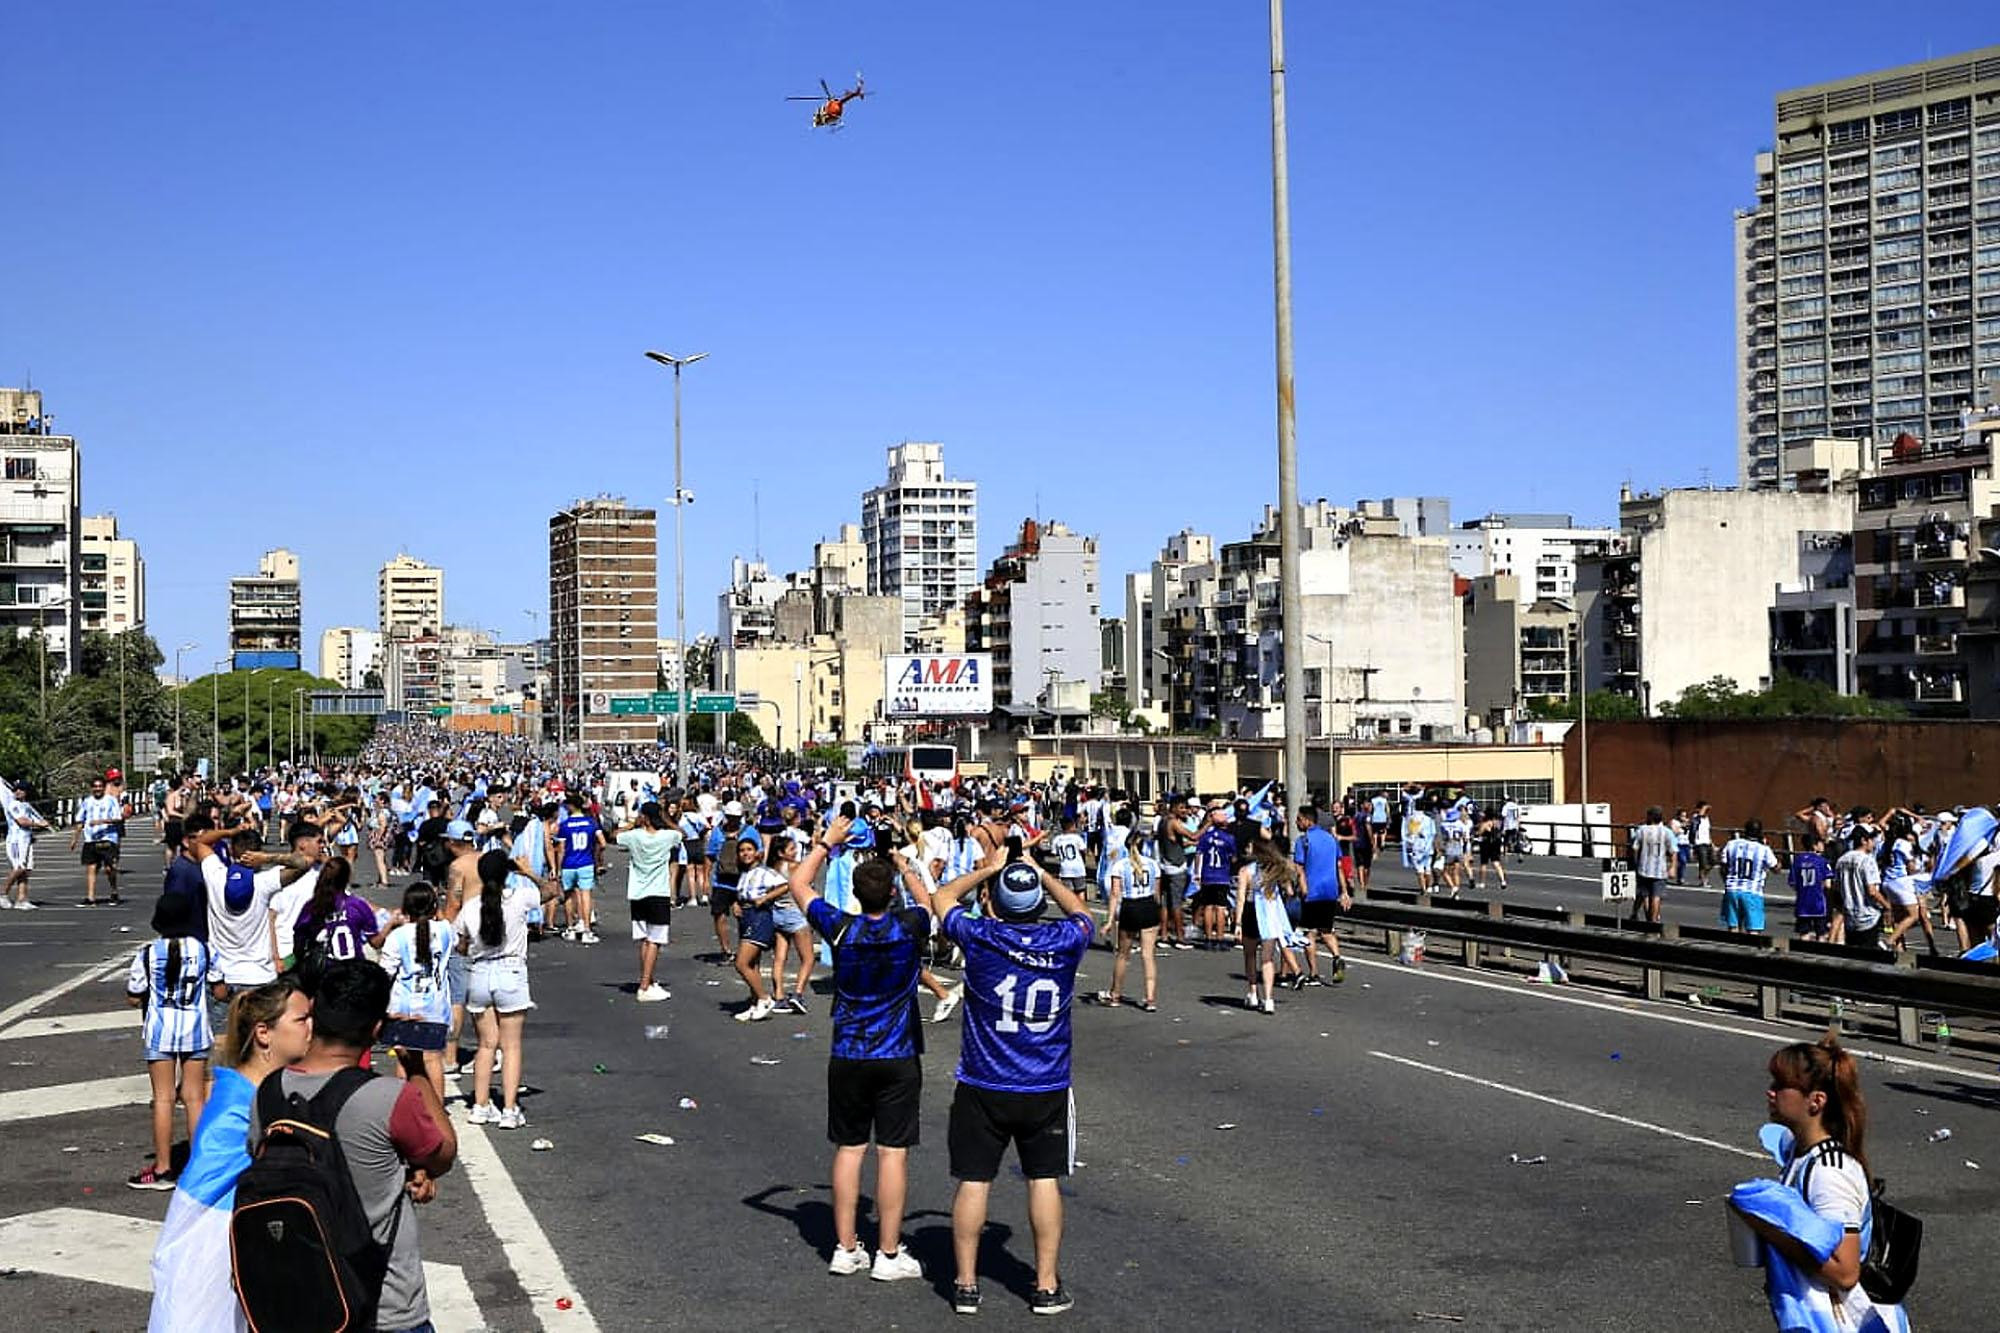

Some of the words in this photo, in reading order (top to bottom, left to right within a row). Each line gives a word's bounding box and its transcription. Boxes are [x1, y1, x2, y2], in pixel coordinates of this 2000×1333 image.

[899, 659, 979, 684] AMA
[572, 832, 588, 850] 10
[1059, 843, 1077, 860] 10
[1209, 846, 1221, 868] 11
[1737, 857, 1754, 880] 10
[1801, 868, 1816, 887] 10
[1132, 870, 1150, 888] 10
[993, 974, 1060, 1032] 10
